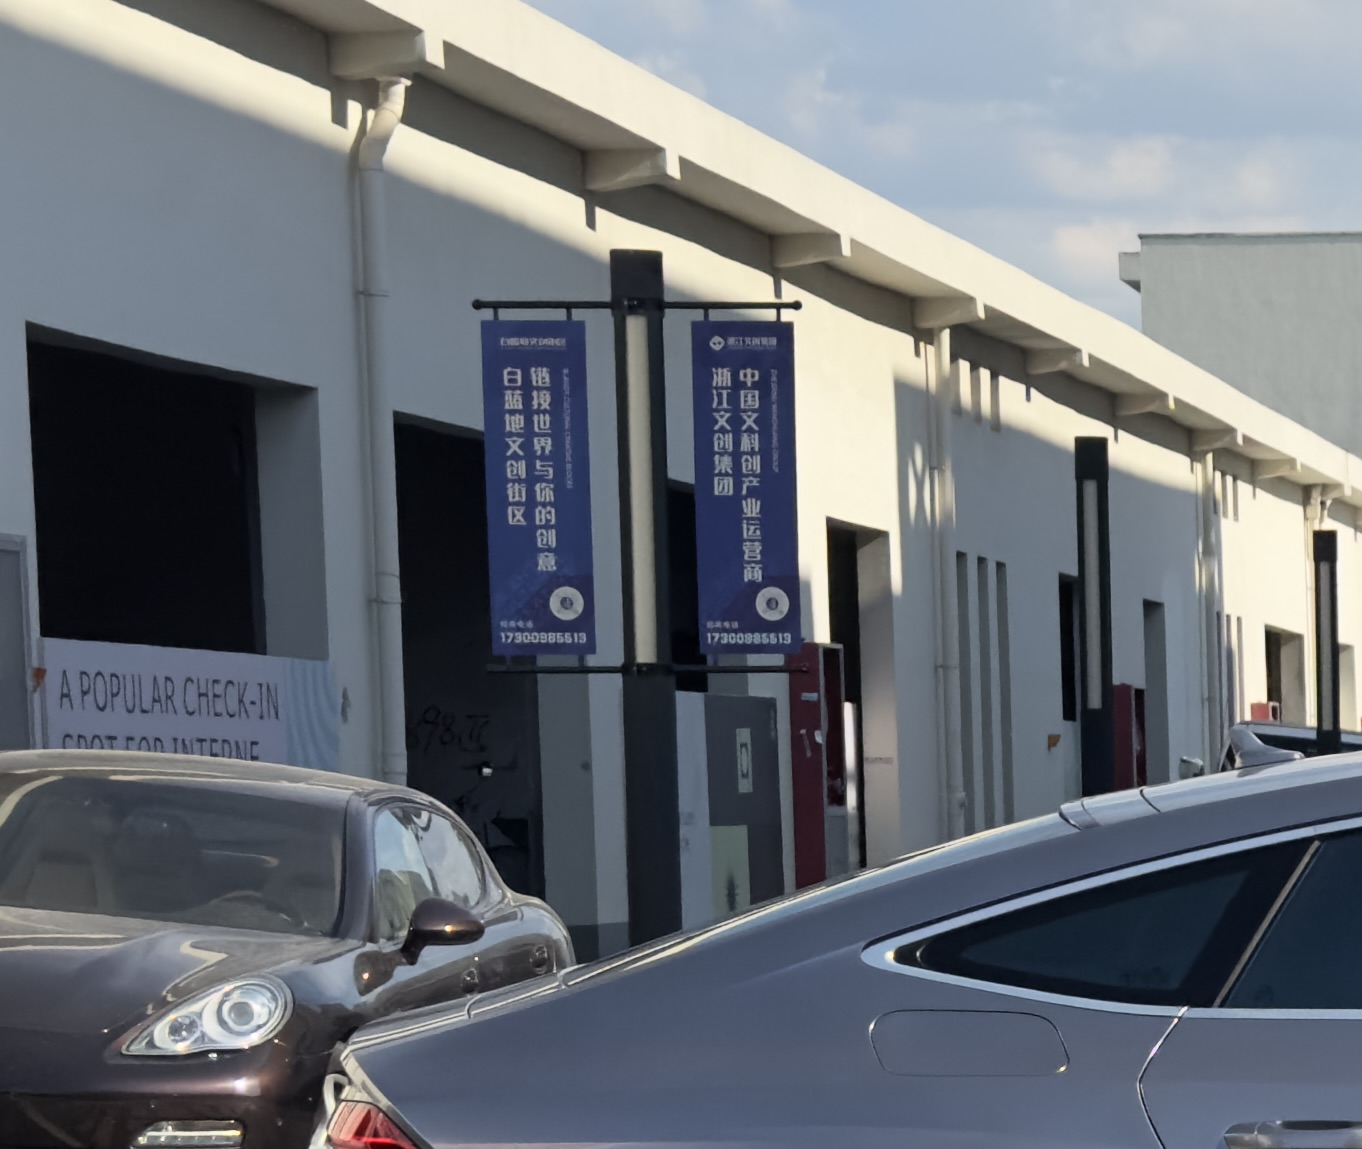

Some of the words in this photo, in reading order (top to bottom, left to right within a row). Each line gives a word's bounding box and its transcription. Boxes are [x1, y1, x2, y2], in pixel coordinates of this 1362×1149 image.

[503, 367, 528, 525] 白蓝地文创街区
[530, 366, 557, 571] 链接世界与你的创意
[712, 367, 734, 496] 浙江文创集团
[739, 367, 763, 583] 中国文科创产业运营商
[59, 669, 74, 711] A
[79, 670, 178, 715] POPULAR
[183, 676, 280, 721] CHECK-IN
